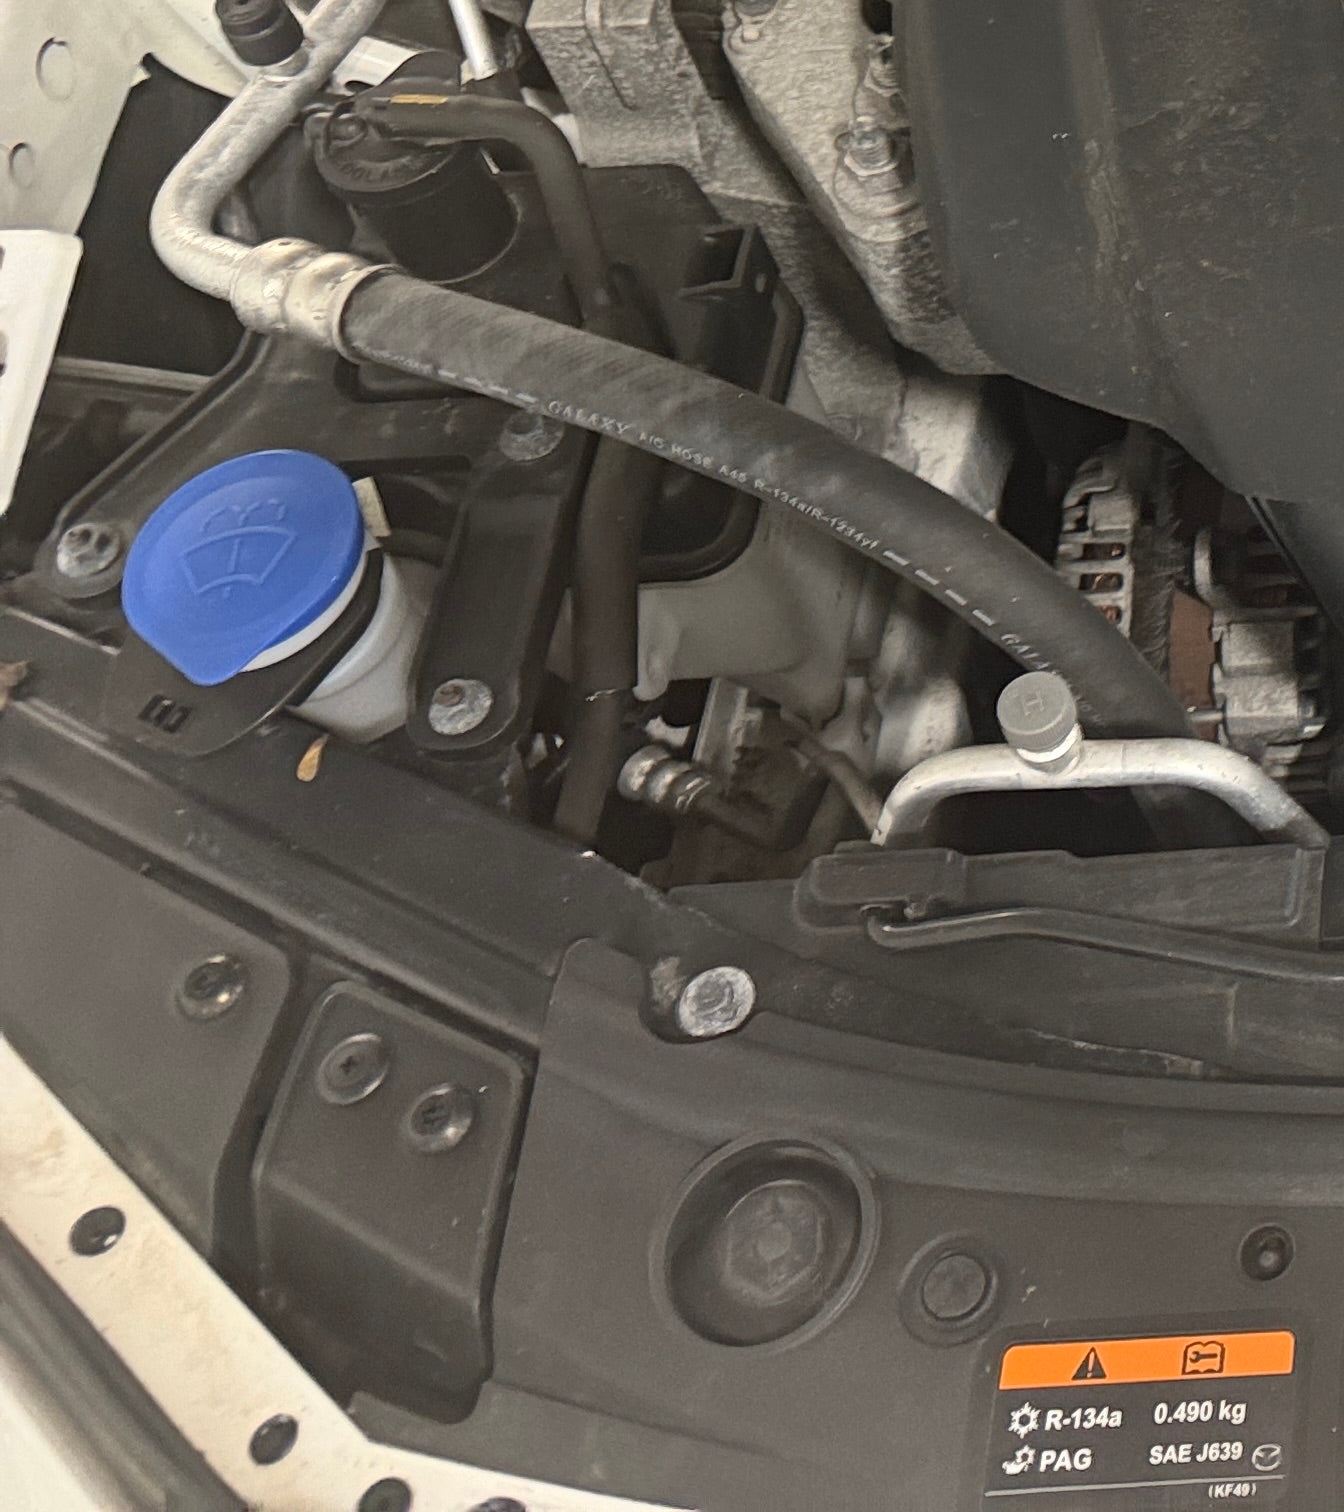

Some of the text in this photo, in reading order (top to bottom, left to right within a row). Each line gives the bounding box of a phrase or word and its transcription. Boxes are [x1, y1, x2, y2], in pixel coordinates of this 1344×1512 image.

[548, 400, 632, 435] GALAXY
[1044, 1399, 1247, 1431] R-134a 0.490 kg
[1039, 1441, 1244, 1472] PAG SAE J639
[1208, 1483, 1257, 1499] (KF49)
